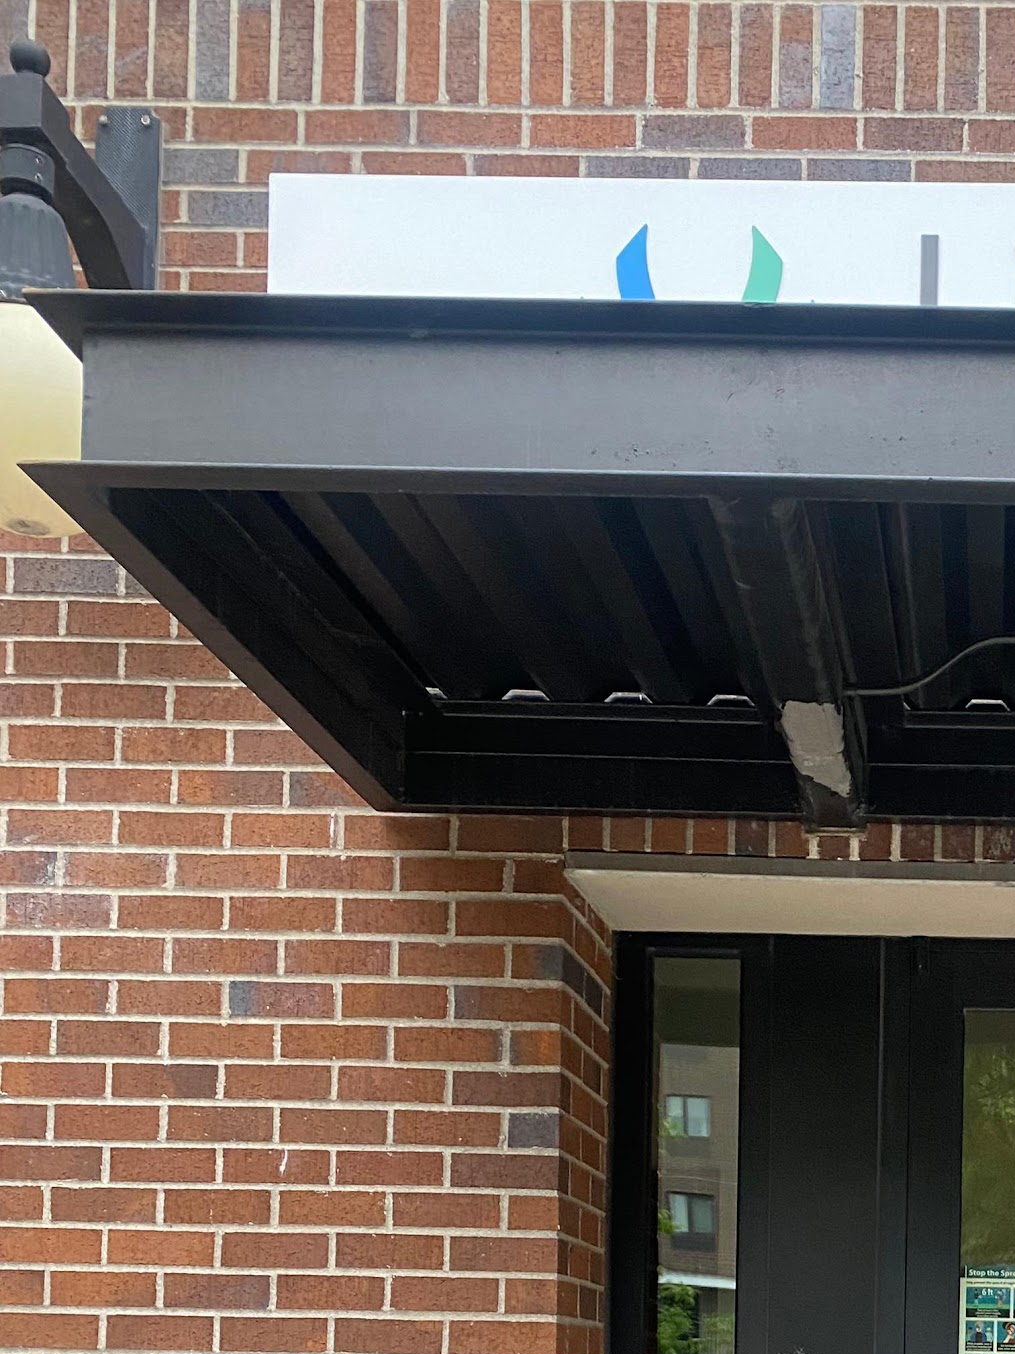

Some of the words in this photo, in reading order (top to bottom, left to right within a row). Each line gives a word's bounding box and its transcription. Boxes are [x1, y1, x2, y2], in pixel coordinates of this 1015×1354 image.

[968, 1269, 986, 1278] Stop
[987, 1269, 1000, 1277] the
[982, 1288, 987, 1296] 6
[987, 1288, 994, 1296] ft
